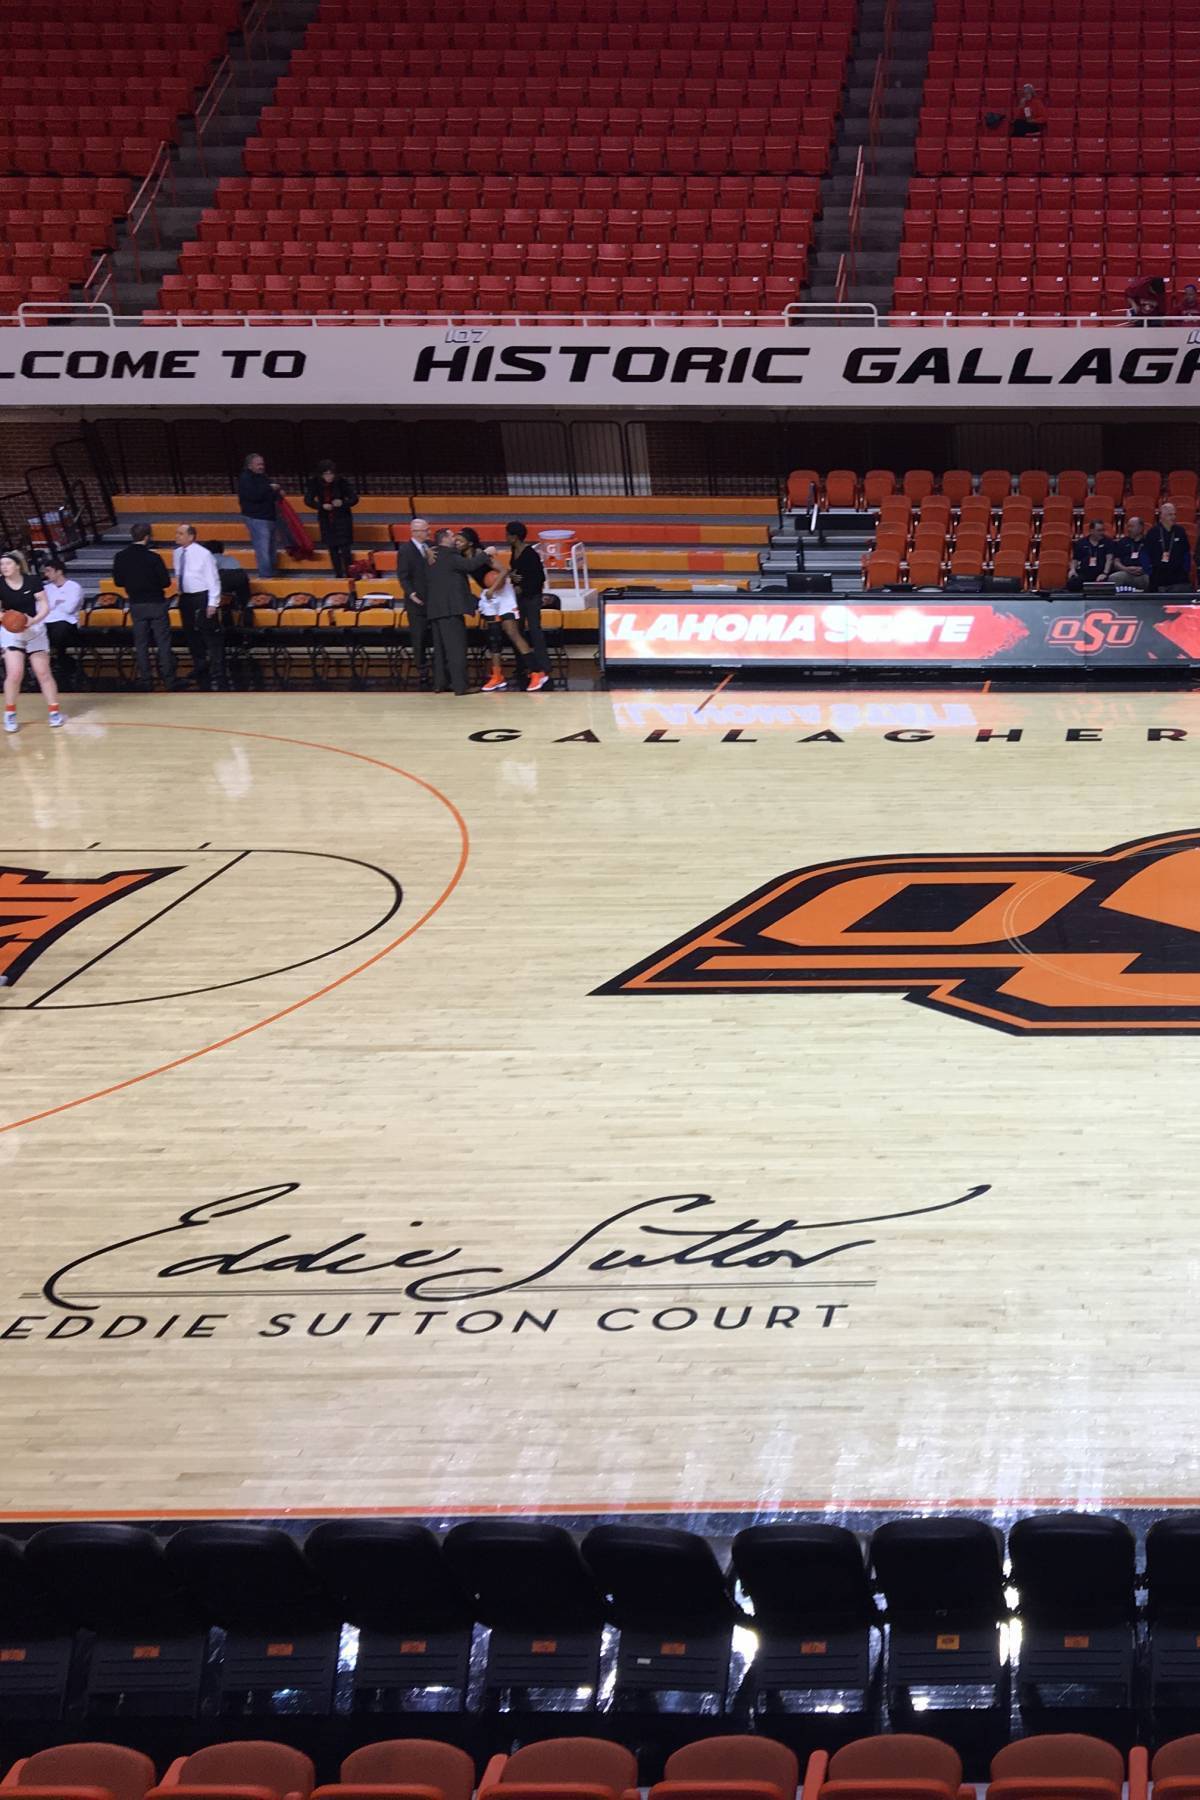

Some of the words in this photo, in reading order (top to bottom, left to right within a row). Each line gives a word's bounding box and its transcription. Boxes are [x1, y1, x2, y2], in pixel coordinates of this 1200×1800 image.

[445, 328, 488, 343] 107
[221, 350, 307, 379] TO
[412, 345, 811, 384] HISTORIC
[822, 609, 976, 642] STE
[1045, 608, 1143, 656] OSU
[0, 1313, 229, 1340] EDDIE
[258, 1307, 559, 1338] SUTTON
[596, 1304, 849, 1332] COURT
